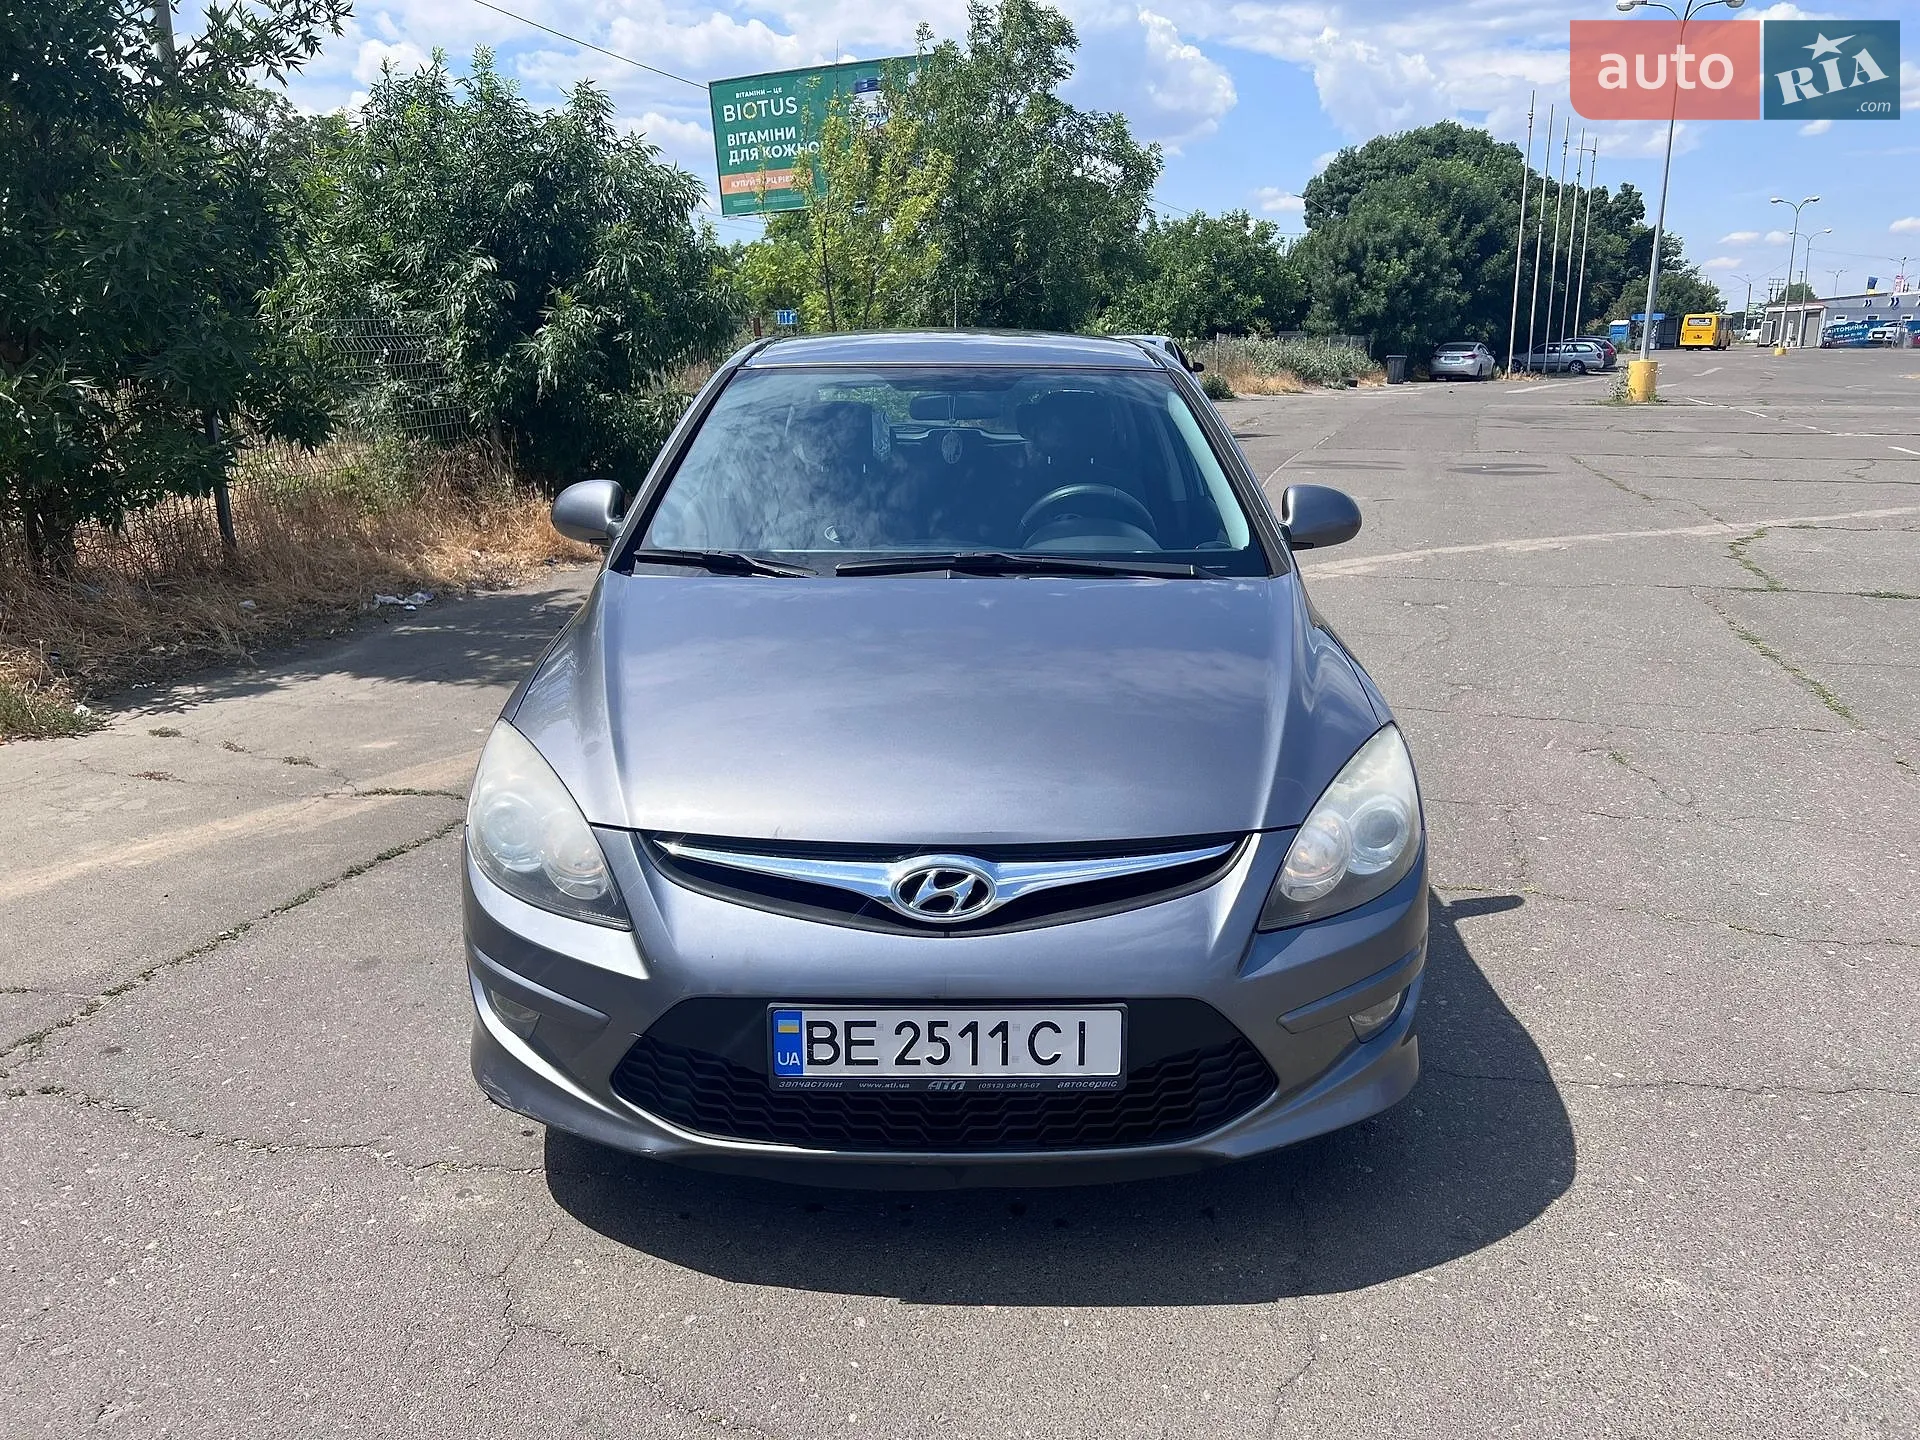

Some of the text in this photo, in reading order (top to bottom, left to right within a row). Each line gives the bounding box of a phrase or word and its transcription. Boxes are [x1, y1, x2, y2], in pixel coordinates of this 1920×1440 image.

[735, 89, 766, 99] ВІТАМІНИ
[723, 97, 798, 122] BIOTUS
[727, 126, 796, 147] ВІТАМІНИ
[728, 147, 759, 166] ДЛЯ
[805, 1020, 1086, 1066] BE 2511 CI
[777, 1051, 801, 1066] UA
